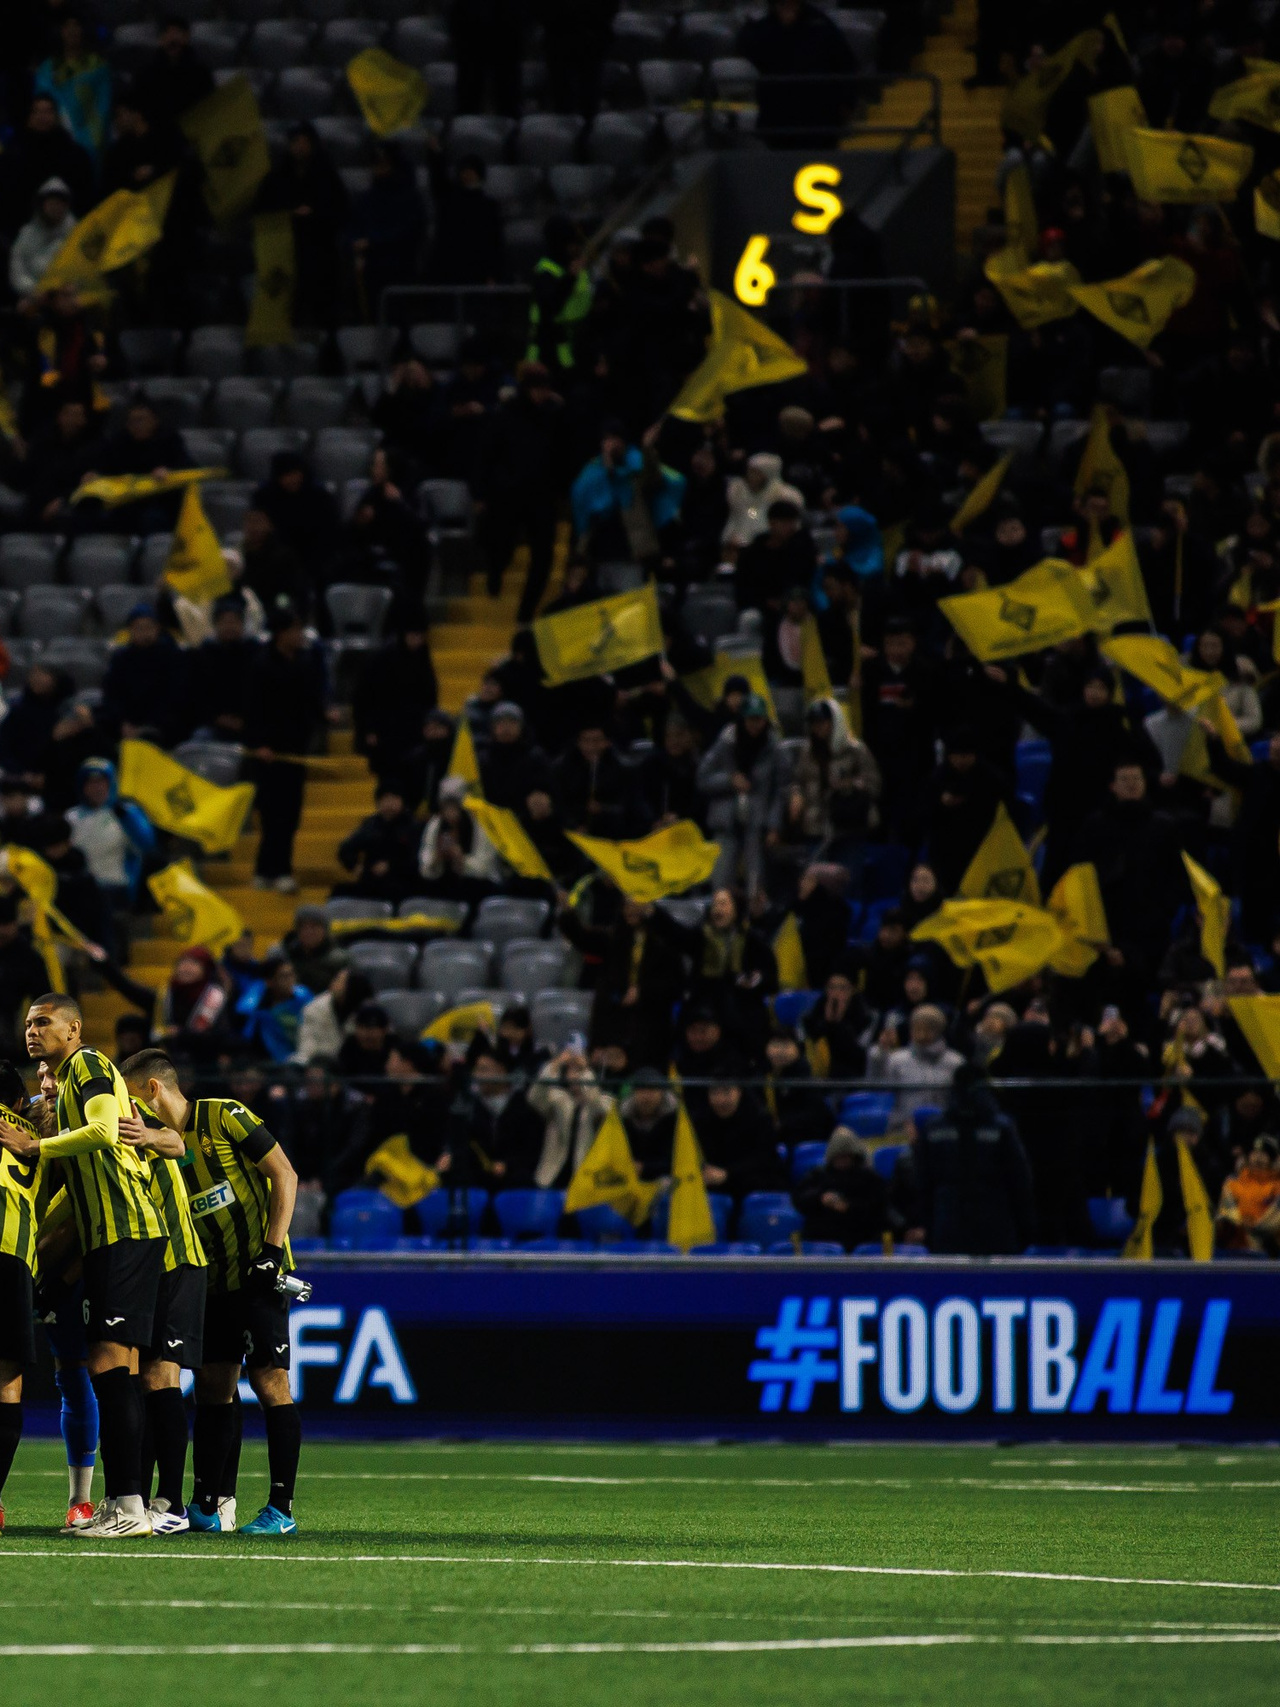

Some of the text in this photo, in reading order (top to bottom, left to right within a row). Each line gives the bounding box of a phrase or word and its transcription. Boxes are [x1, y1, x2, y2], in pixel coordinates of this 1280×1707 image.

[791, 161, 845, 236] S
[732, 232, 777, 308] 6
[82, 1299, 91, 1326] 6
[746, 1296, 1236, 1415] #FOOTBALL
